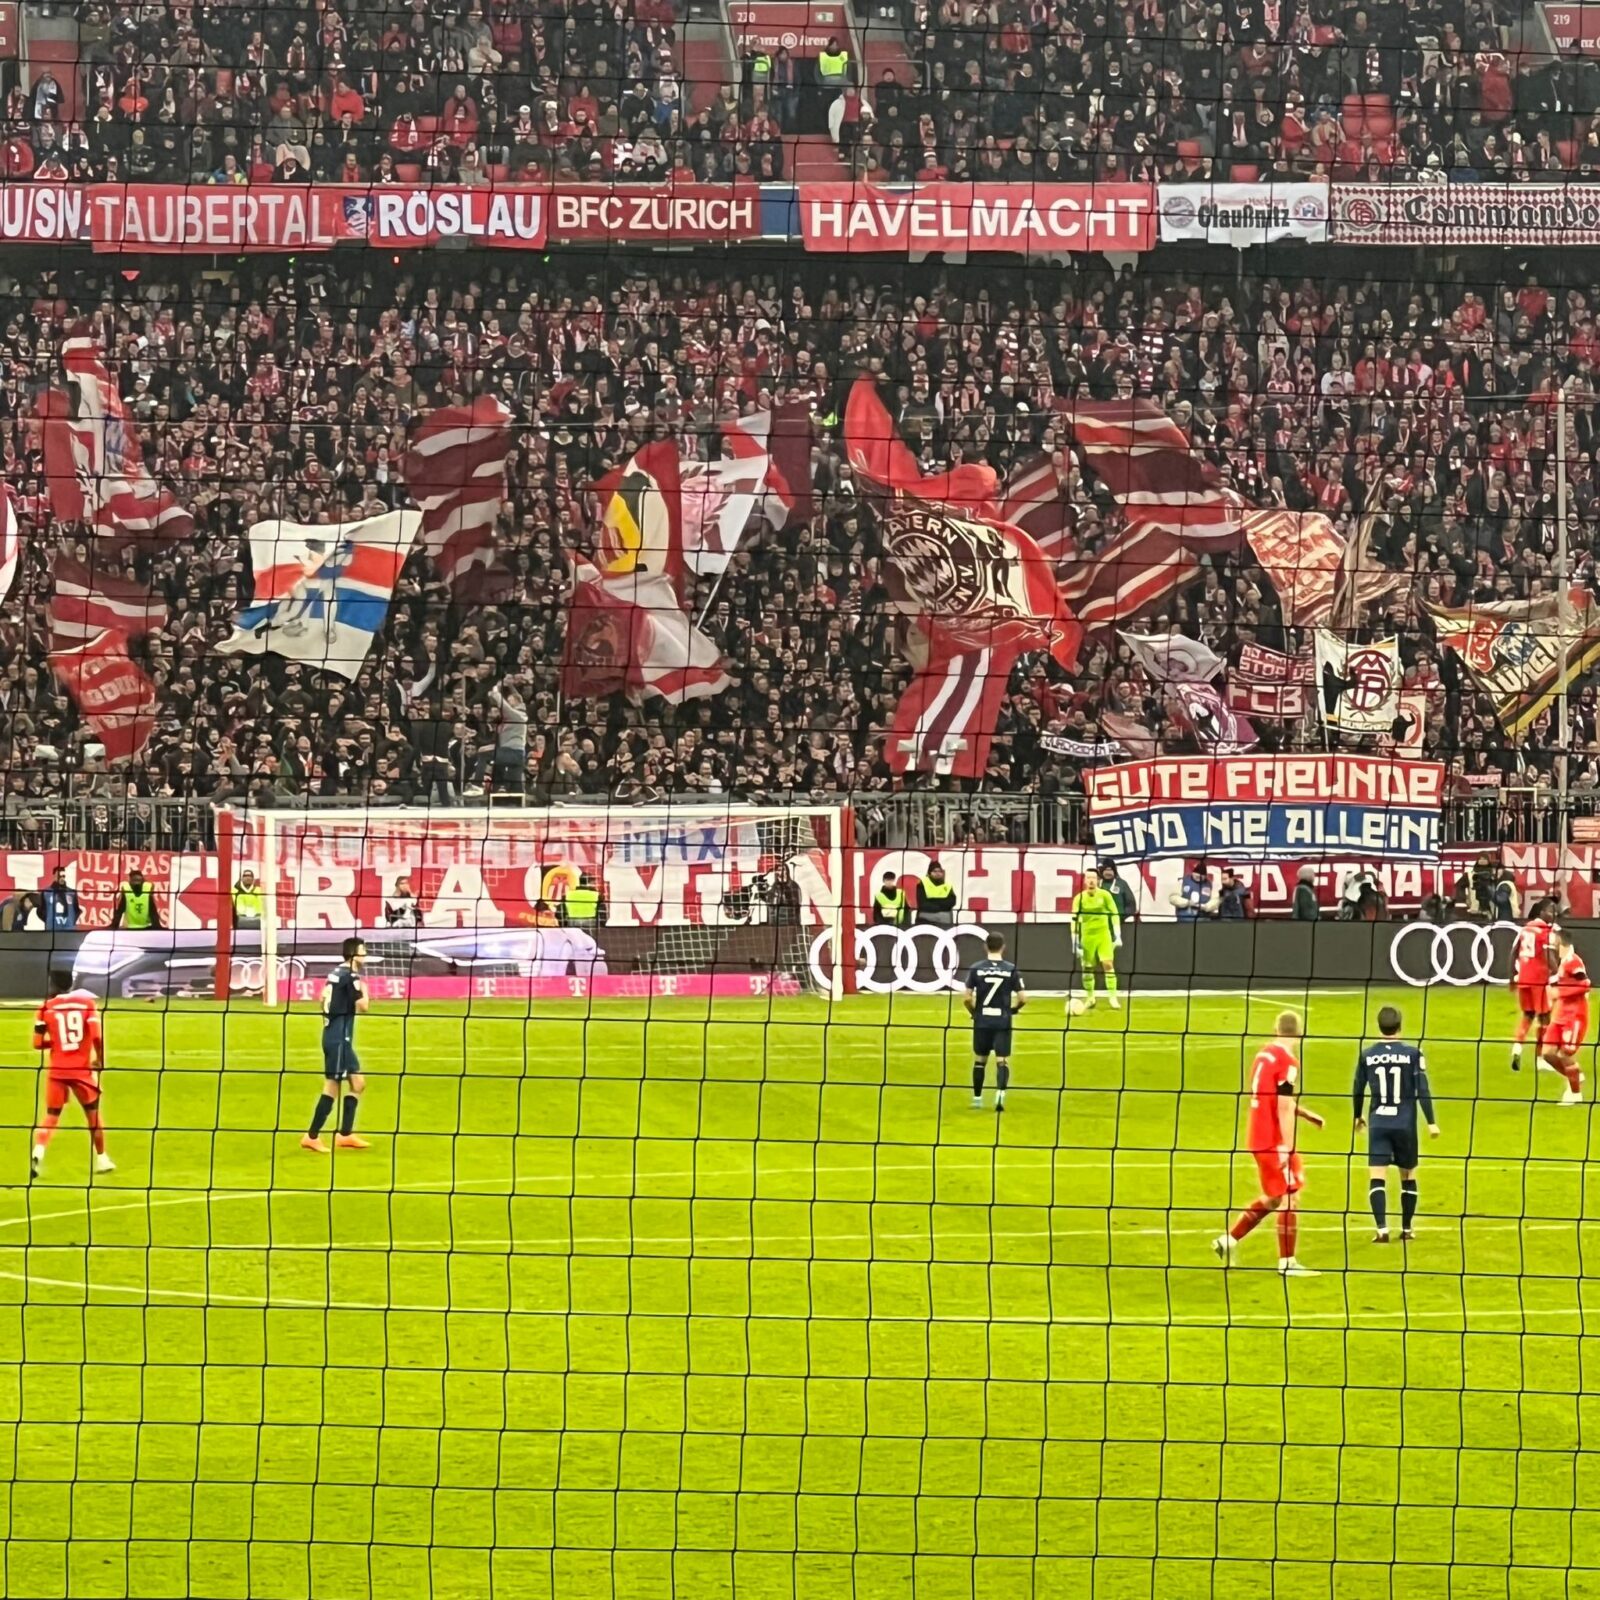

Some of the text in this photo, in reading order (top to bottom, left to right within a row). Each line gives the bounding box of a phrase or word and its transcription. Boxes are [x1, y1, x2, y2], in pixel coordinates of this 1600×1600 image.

[1553, 14, 1570, 25] 219
[800, 35, 829, 46] Aren
[96, 195, 333, 243] TAUBERTAL
[378, 191, 540, 239] RÖSLAU
[556, 194, 753, 230] BFC ZÜRICH
[810, 198, 1148, 238] HAVELMACHT
[79, 853, 170, 875] ULTRAS
[76, 879, 170, 902] GEN
[983, 976, 1004, 1006] 7
[54, 1010, 84, 1046] 19
[1374, 1066, 1401, 1104] 11
